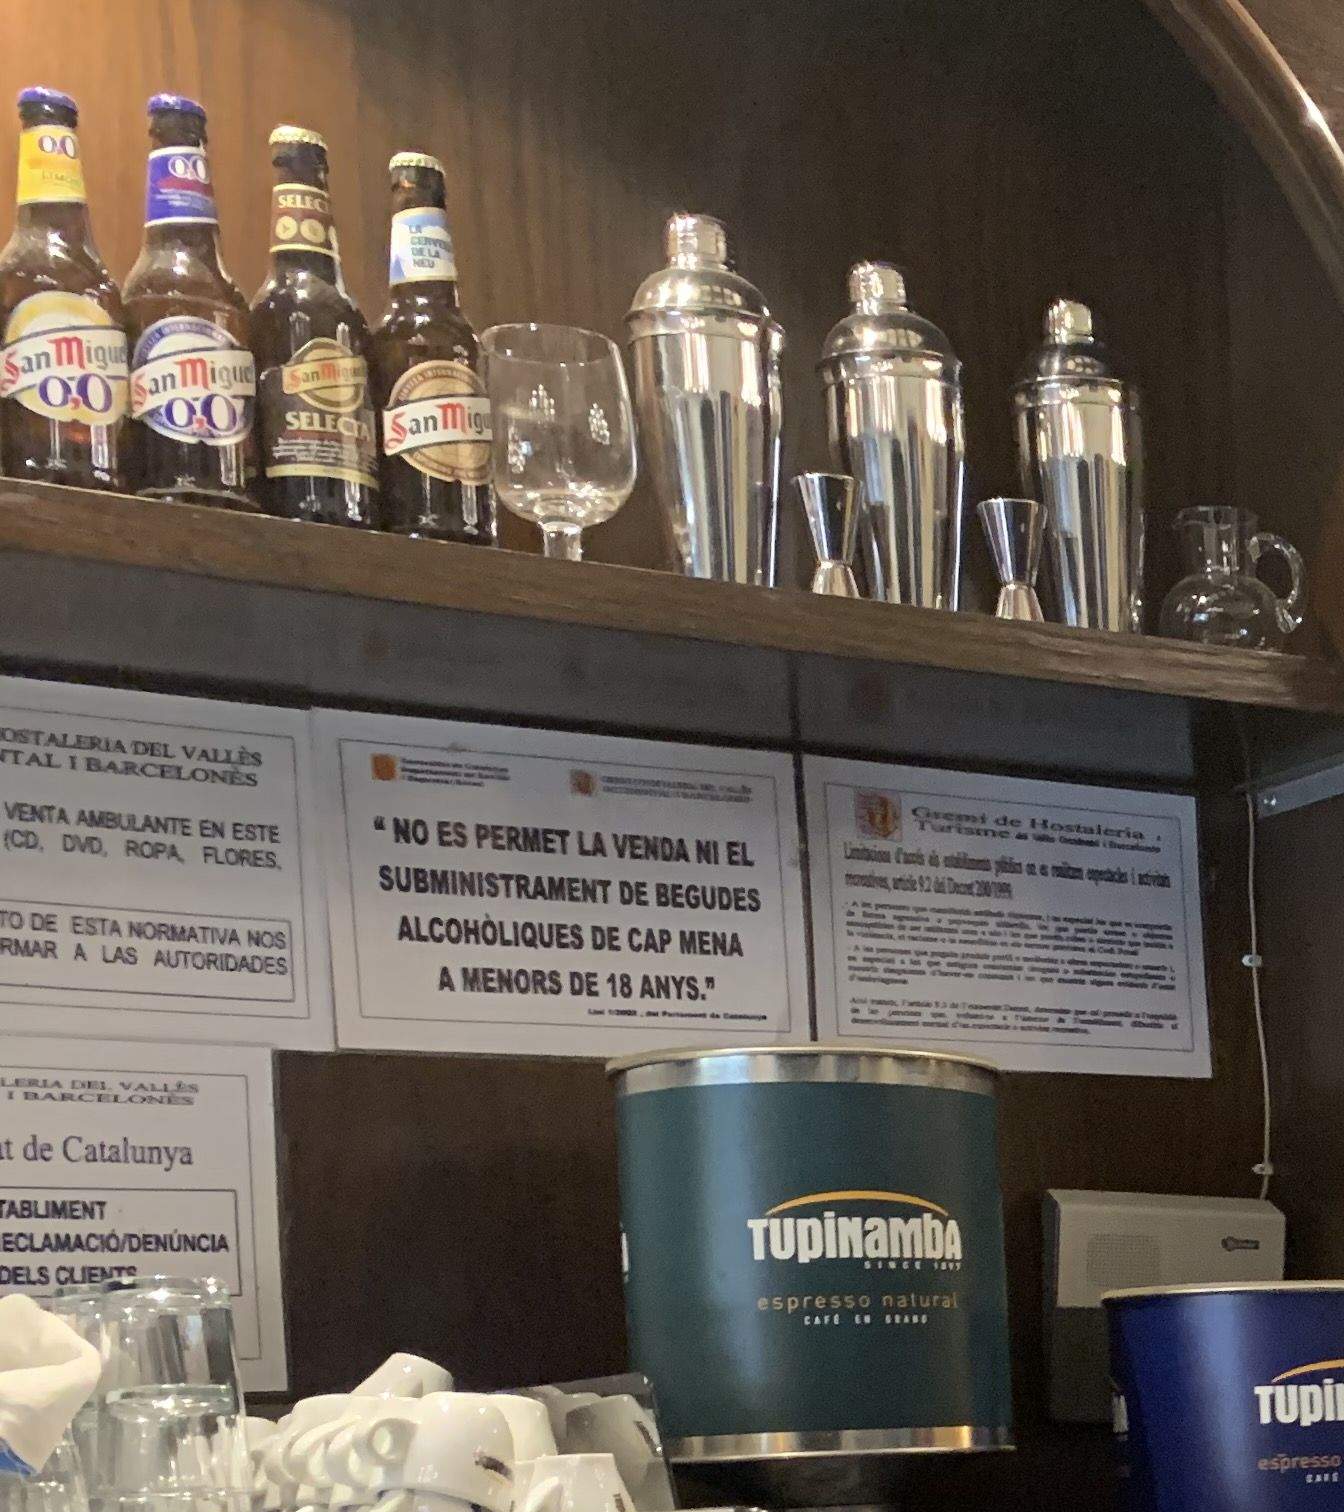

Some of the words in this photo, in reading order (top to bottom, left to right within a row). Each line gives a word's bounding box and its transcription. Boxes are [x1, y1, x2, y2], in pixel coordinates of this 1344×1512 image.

[132, 741, 175, 758] DEL
[182, 746, 262, 767] VALLÈS
[86, 757, 257, 787] BARCELONÈS
[4, 802, 69, 825] VENTA
[76, 810, 190, 837] AMBULANTE
[200, 819, 225, 839] EN
[232, 823, 281, 844] ESTE
[393, 816, 430, 845] NO
[437, 821, 469, 848] ES
[475, 824, 571, 855] PERMET
[577, 830, 608, 858] LA
[612, 833, 690, 863] VENDA
[696, 839, 720, 865] NI
[726, 841, 755, 867] EL
[378, 865, 612, 905] SUBMINISTRAMENT
[619, 880, 648, 906] DE
[655, 883, 762, 912] BEGUDES
[31, 912, 58, 933] DE
[71, 916, 121, 937] ESTA
[128, 921, 241, 946] NORMATIVA
[248, 929, 287, 949] NOS
[398, 913, 585, 951] ALCOHÒLIQUES
[591, 925, 622, 952] DE
[628, 926, 673, 954] CAP
[679, 929, 745, 958] MENA
[74, 942, 87, 961] A
[102, 945, 138, 965] LAS
[154, 949, 288, 975] AUTORIDADES
[438, 966, 455, 993] A
[462, 967, 562, 996] MENORS
[569, 970, 599, 998] DE
[606, 972, 632, 999] 18
[23, 1134, 53, 1162] de
[62, 1135, 194, 1172] Catalunya
[757, 1294, 871, 1314] espresso
[882, 1292, 959, 1309] natural
[1257, 1453, 1341, 1474] espresso
